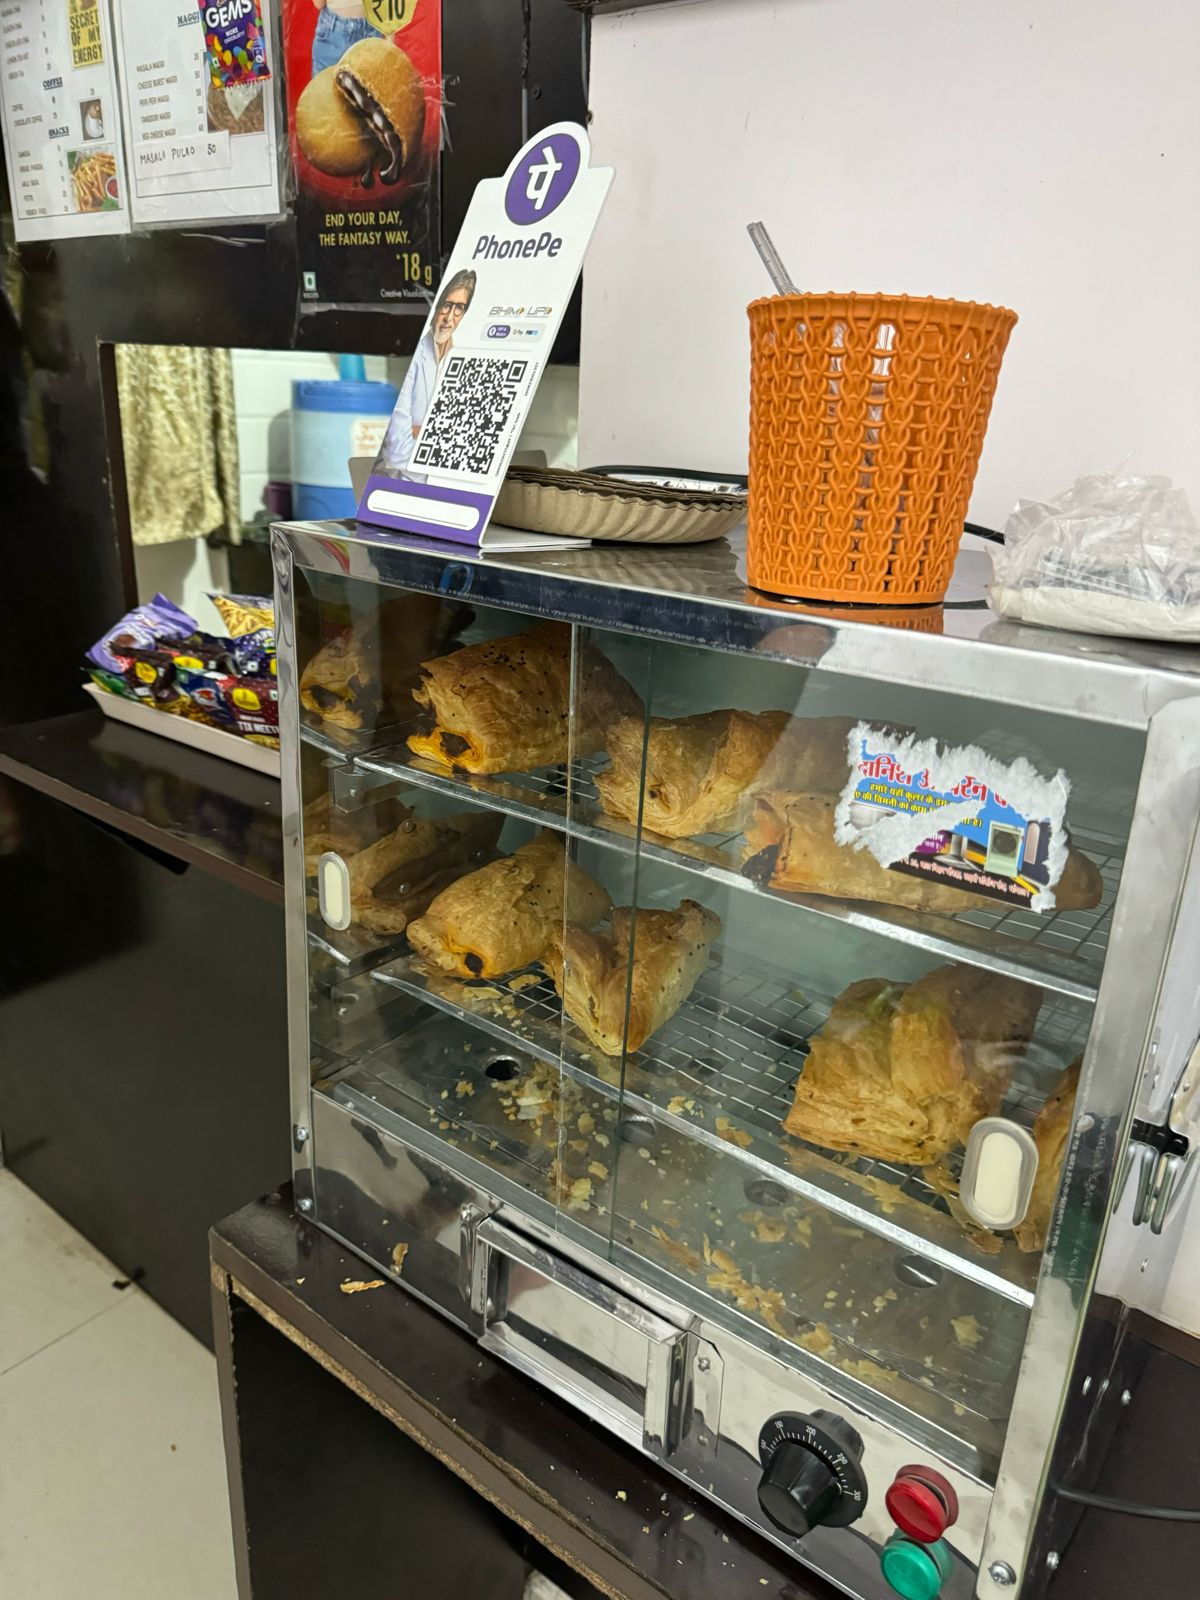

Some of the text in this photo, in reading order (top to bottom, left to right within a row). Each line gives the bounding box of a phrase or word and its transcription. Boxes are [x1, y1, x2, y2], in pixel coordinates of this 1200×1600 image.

[70, 9, 98, 30] SECRET
[205, 0, 252, 28] GEMS
[71, 25, 100, 46] OF MY
[73, 43, 103, 65] ENERGY
[140, 143, 217, 165] MASALA PULAO 50
[526, 145, 563, 210] पे
[325, 211, 403, 227] END YOUR DAY,
[319, 231, 411, 247] THE FANTASY WAY.
[472, 231, 563, 260] PhonePe
[424, 265, 433, 286] g
[489, 306, 548, 316] BHIM UPI
[806, 1425, 817, 1436] 200
